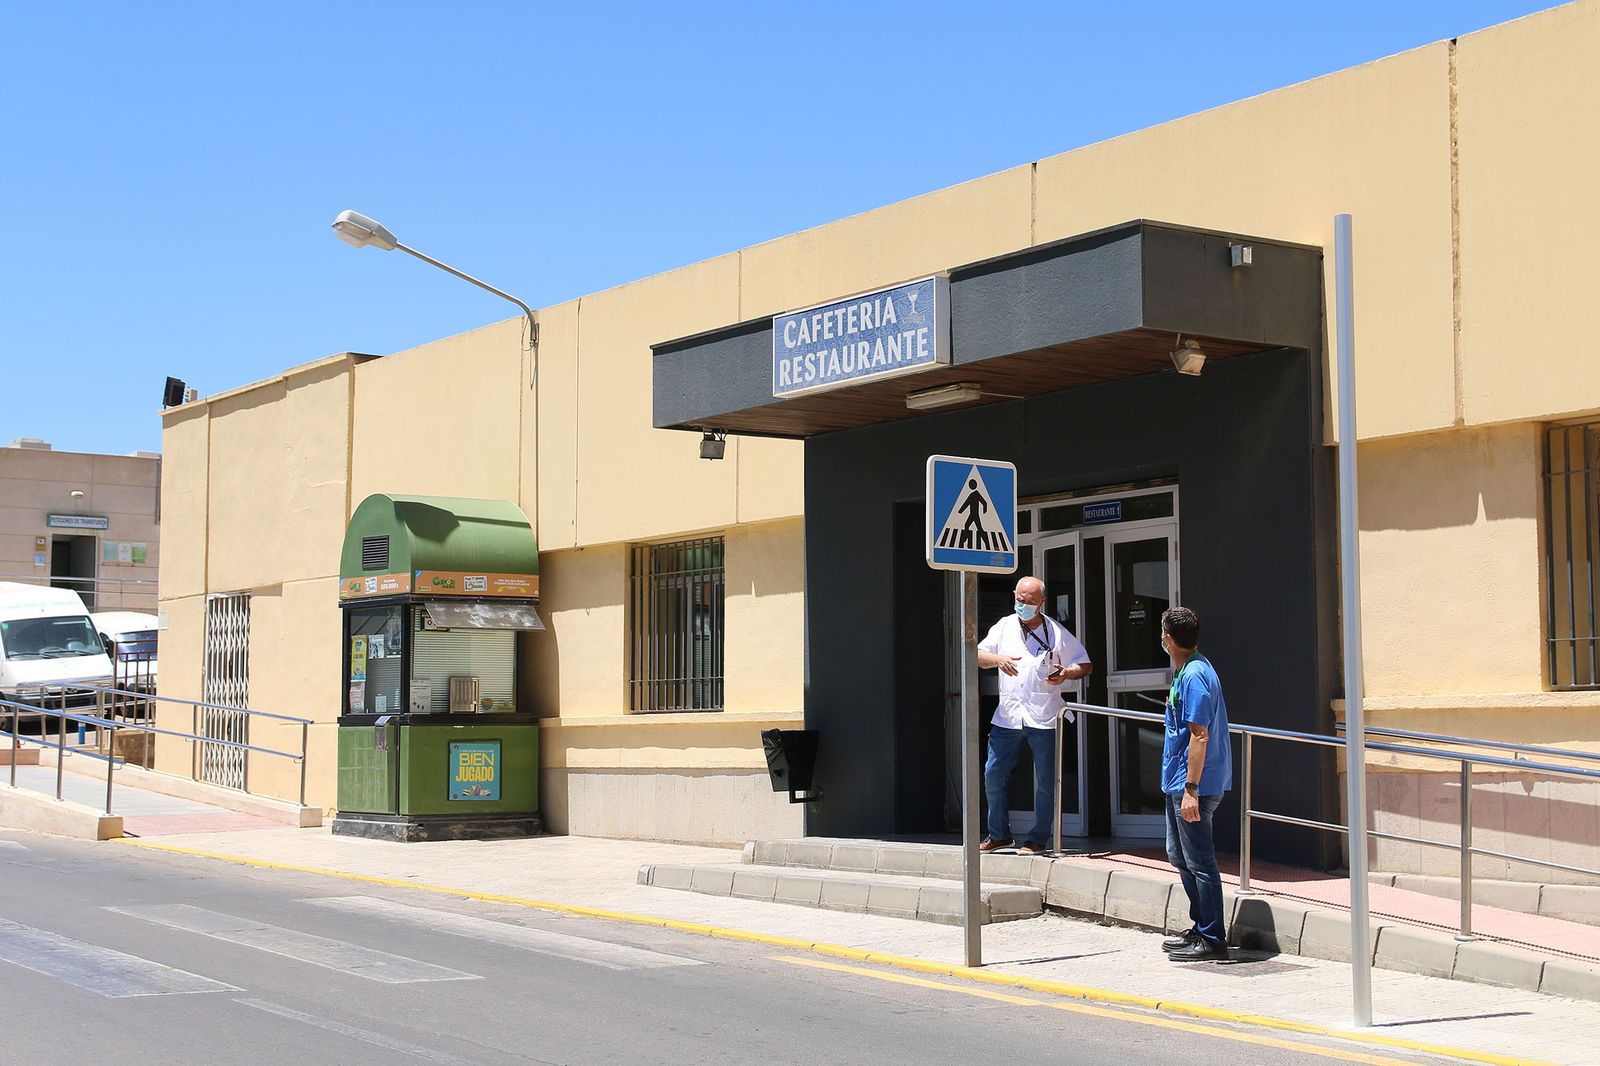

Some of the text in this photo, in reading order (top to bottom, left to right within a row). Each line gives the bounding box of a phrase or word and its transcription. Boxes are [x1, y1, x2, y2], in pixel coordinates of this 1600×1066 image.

[783, 296, 898, 349] CAFETERIA
[779, 326, 929, 387] RESTAURANTE
[1085, 507, 1116, 518] RESTAURANTE
[459, 752, 495, 766] BIEN
[455, 766, 495, 782] JUGADO
